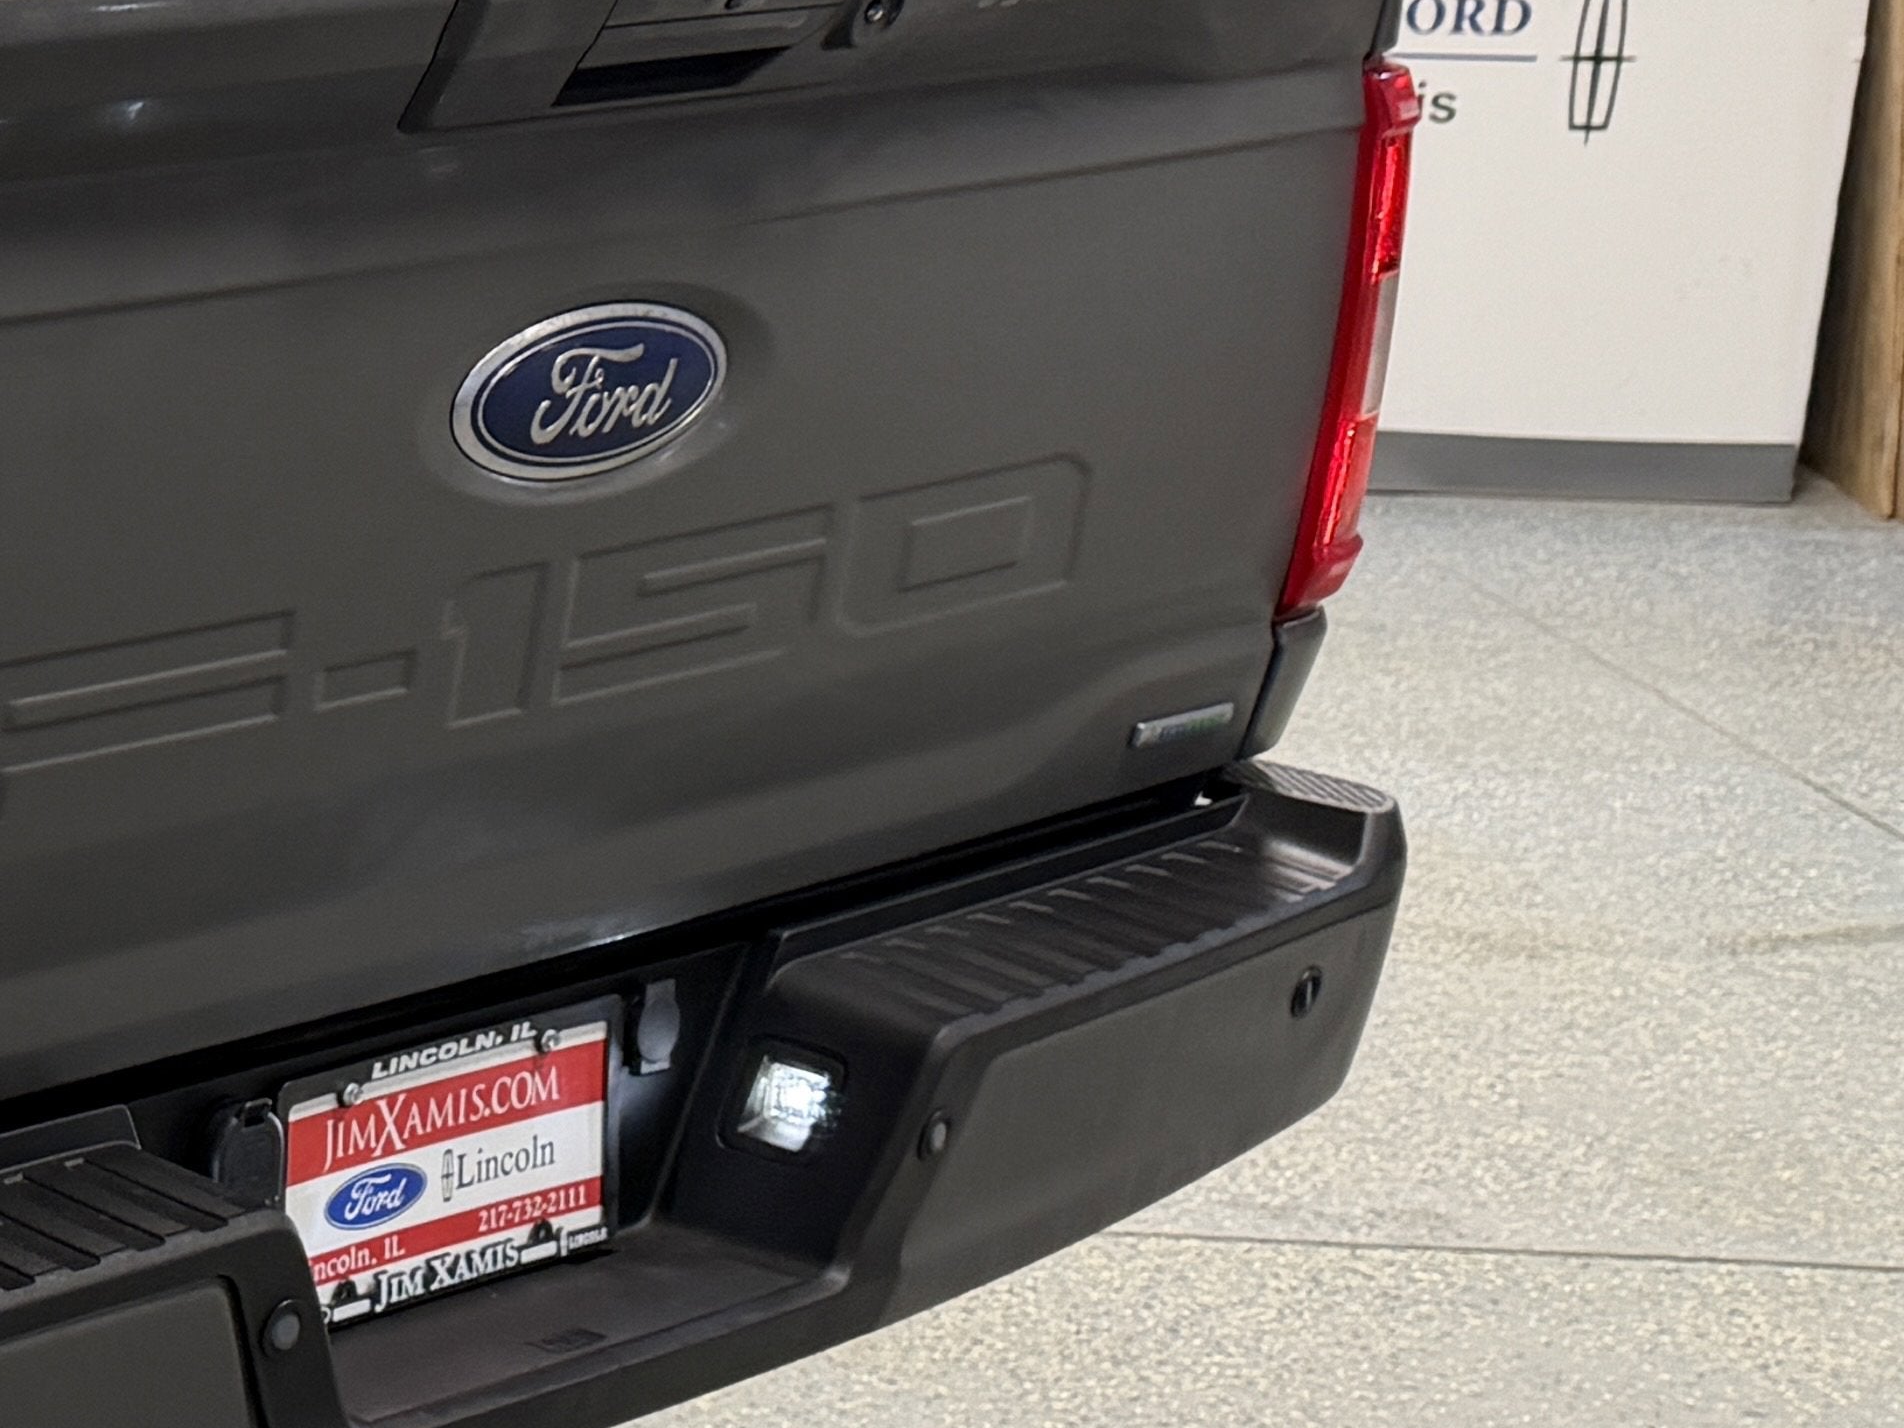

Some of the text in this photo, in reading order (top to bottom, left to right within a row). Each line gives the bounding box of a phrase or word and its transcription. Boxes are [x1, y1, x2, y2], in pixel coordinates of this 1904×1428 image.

[529, 342, 679, 446] Ford
[510, 1021, 539, 1042] IL
[456, 1134, 556, 1191] Lincoln
[344, 1171, 406, 1221] Ford
[478, 1184, 587, 1232] 217-732-2111
[384, 1234, 406, 1260] IL
[374, 1239, 520, 1313] JIM XAMIS
